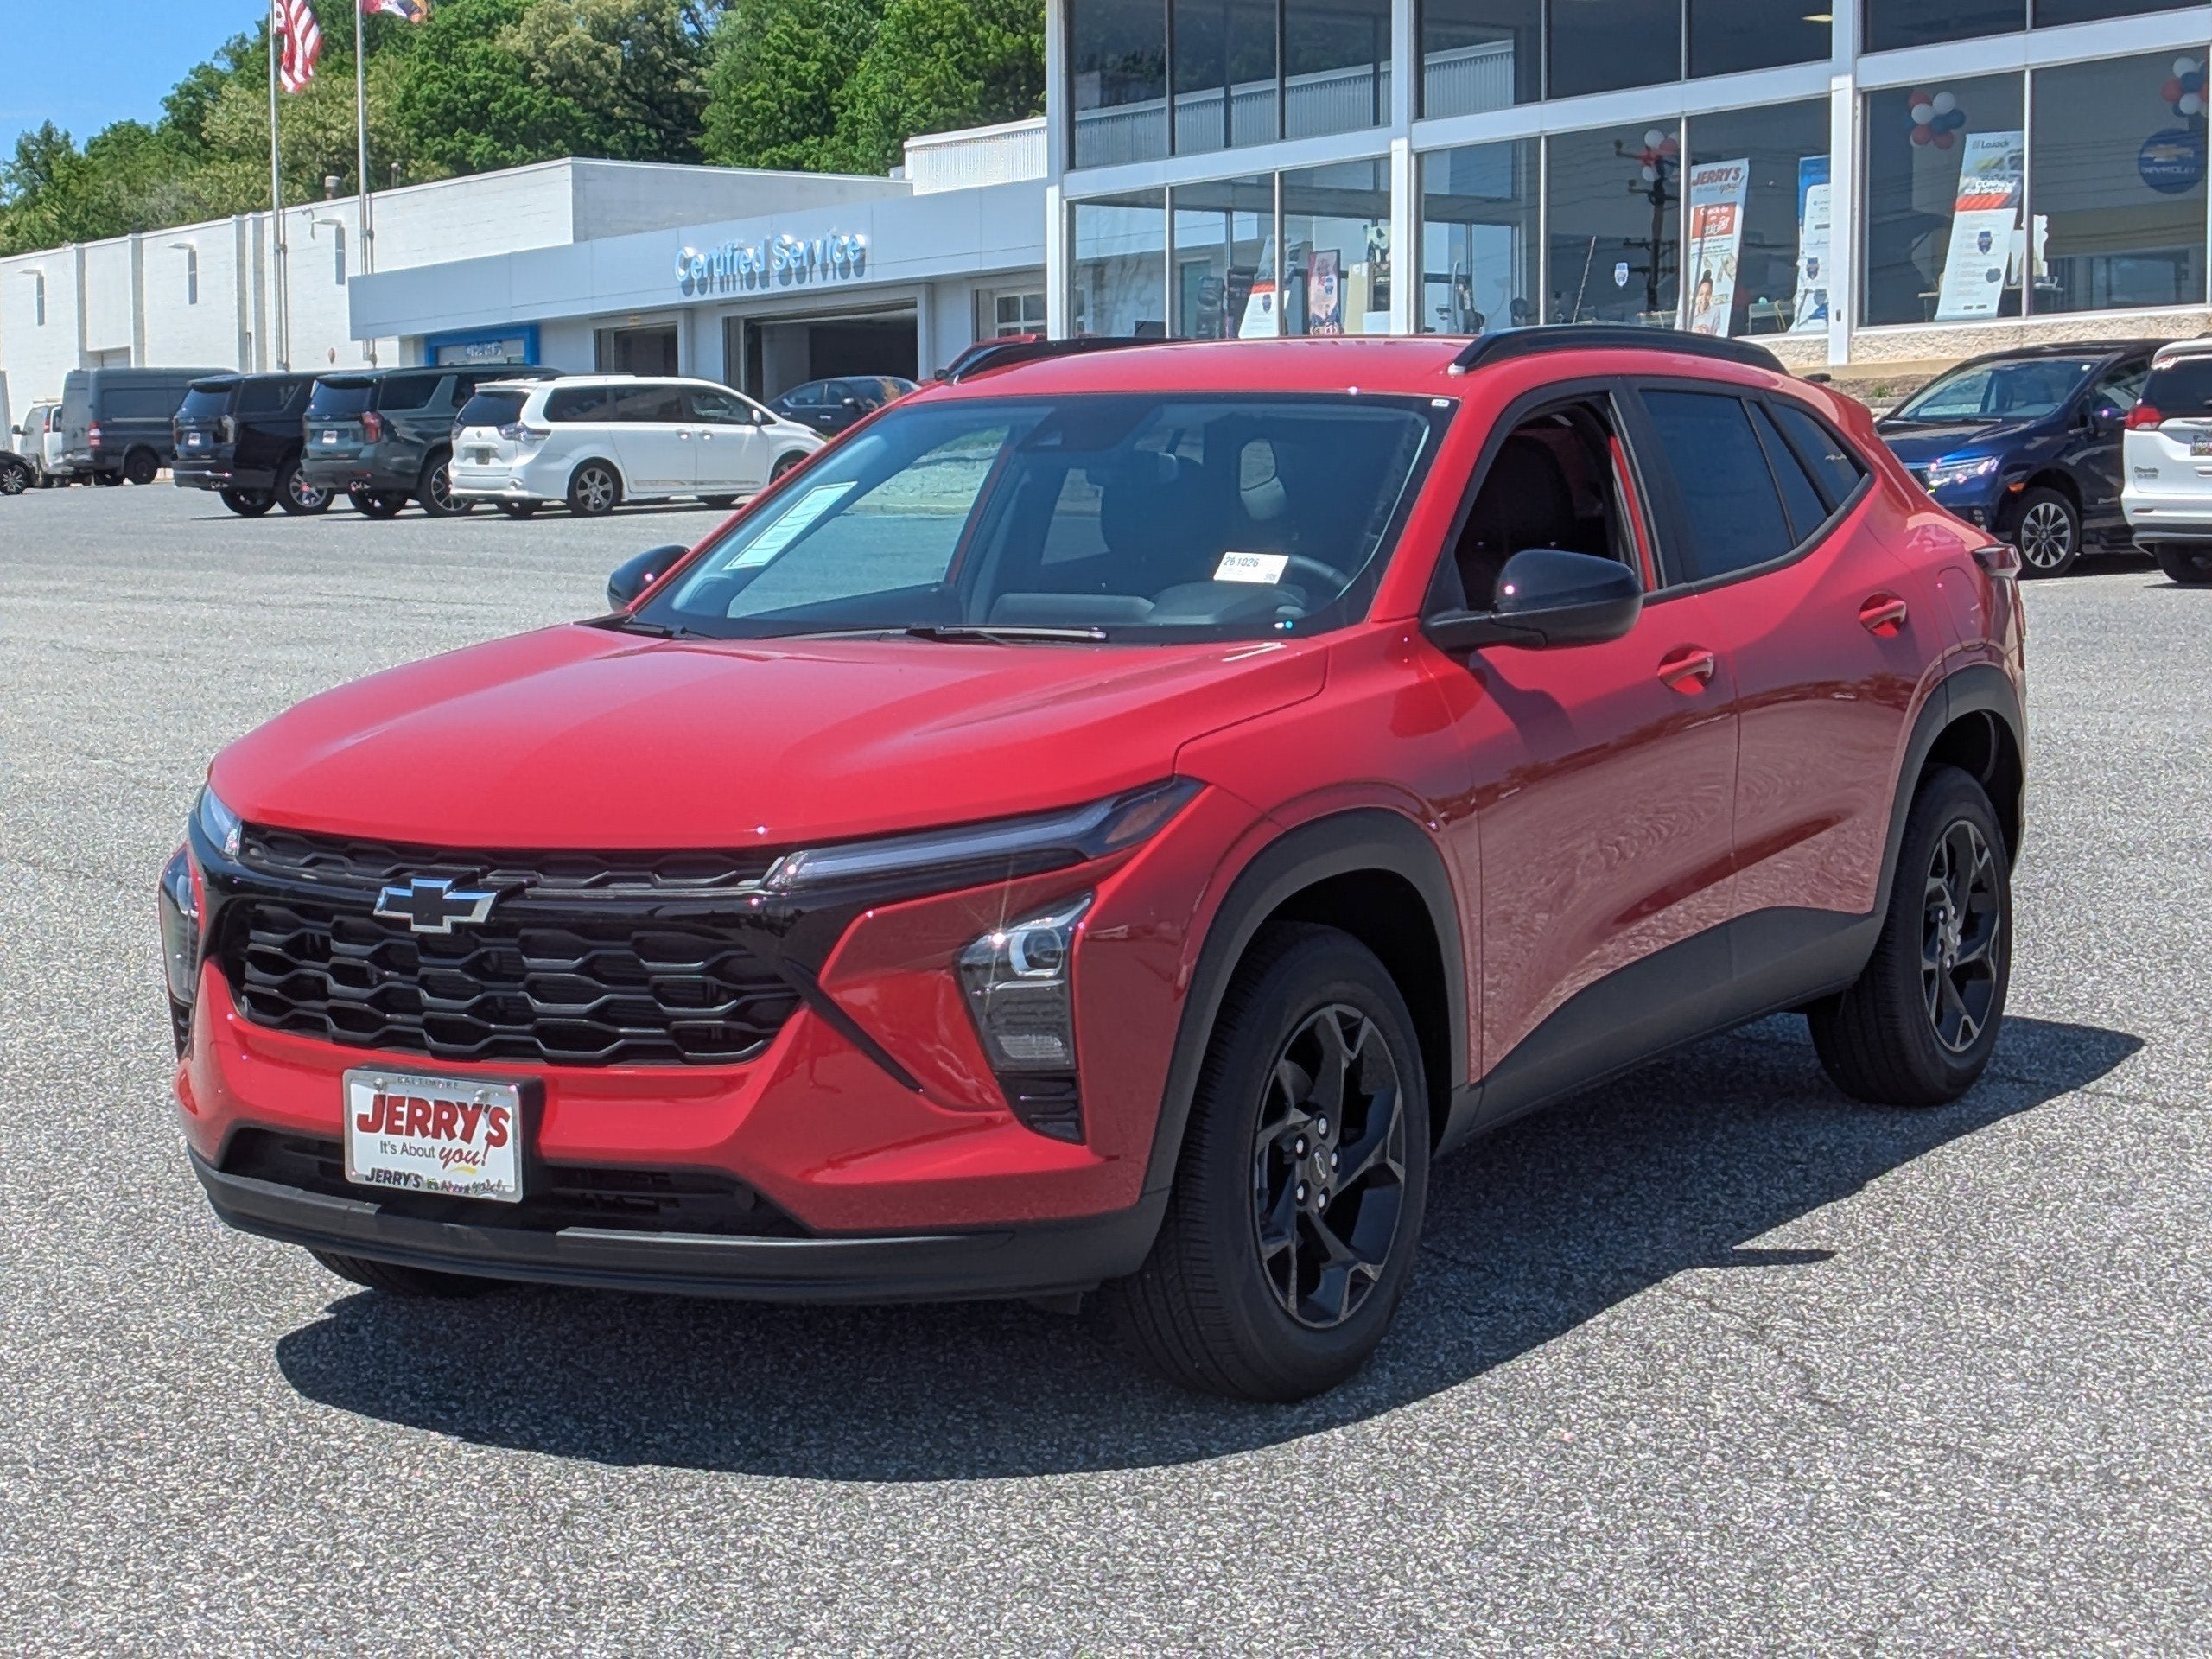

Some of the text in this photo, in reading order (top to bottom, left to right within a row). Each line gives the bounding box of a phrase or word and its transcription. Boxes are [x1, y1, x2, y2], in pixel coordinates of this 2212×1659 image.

[1691, 167, 1741, 186] JERRY'S
[675, 228, 866, 282] Certified Service
[1224, 556, 1260, 568] 261026
[356, 1094, 511, 1147] JERRY'S
[379, 1140, 491, 1170] It's About you!
[365, 1167, 423, 1188] JERRY'S
